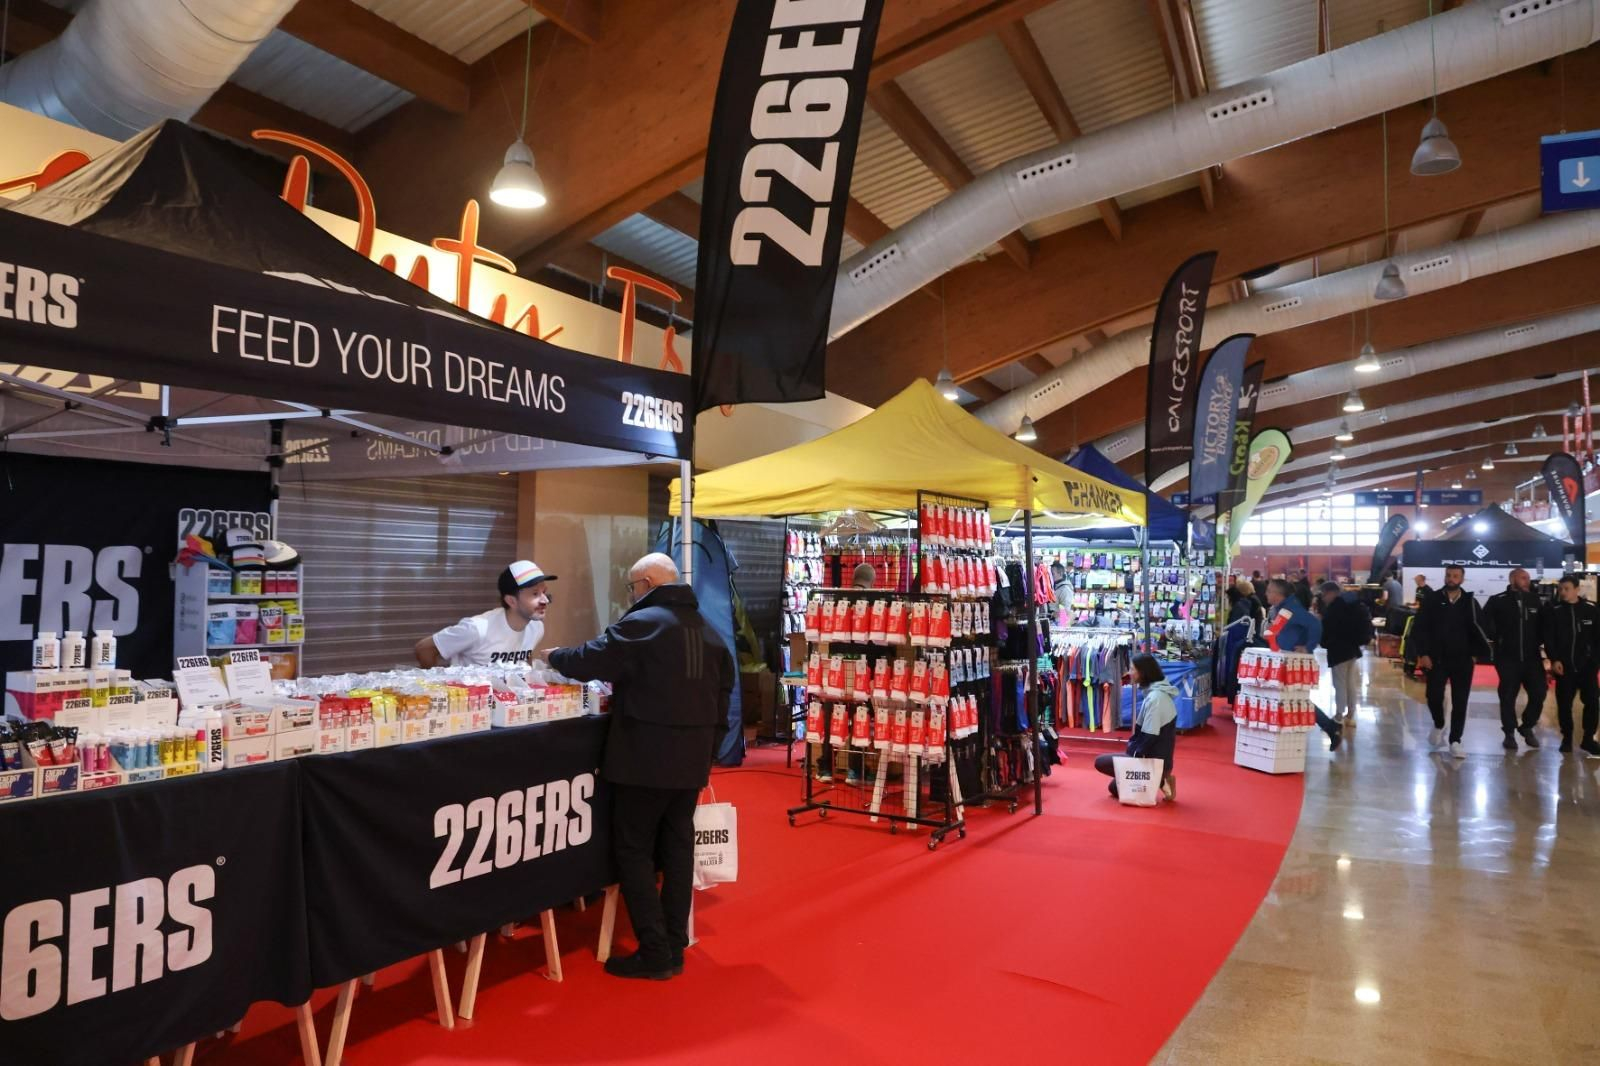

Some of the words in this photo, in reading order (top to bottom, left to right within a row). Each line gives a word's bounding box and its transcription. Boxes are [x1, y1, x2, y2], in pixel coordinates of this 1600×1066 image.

[211, 303, 320, 368] FEED
[332, 327, 433, 388] YOUR
[444, 351, 567, 414] DREAMS
[622, 391, 684, 433] 226ERS
[1202, 389, 1222, 464] VICTORY
[179, 657, 209, 669] 226ERS
[231, 651, 259, 663] 226ERS
[109, 695, 133, 705] 226ERS
[147, 690, 170, 699] 226ERS
[65, 699, 91, 709] 226ERS
[211, 728, 222, 763] 226ERS
[1125, 770, 1151, 781] 226ERS
[430, 773, 595, 889] 226ERS
